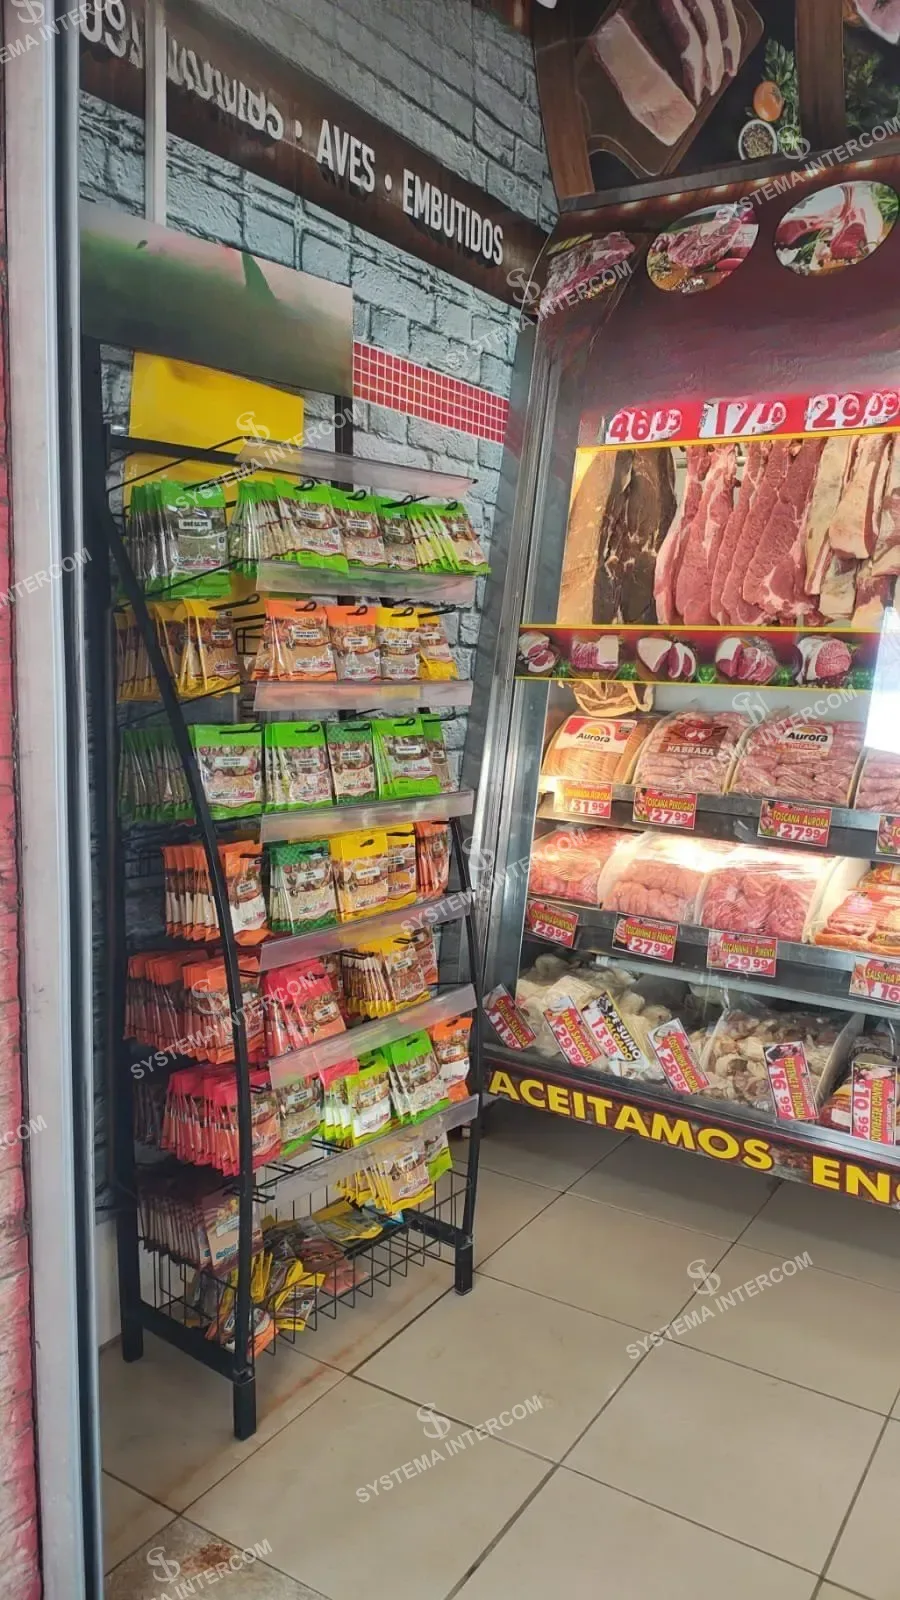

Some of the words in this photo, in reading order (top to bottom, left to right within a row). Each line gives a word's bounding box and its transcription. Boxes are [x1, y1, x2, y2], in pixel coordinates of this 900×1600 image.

[316, 118, 376, 193] AVES
[402, 168, 504, 265] EMBUTIDOS
[576, 732, 611, 743] Aurora
[787, 732, 829, 743] Aurora
[645, 796, 668, 808] TOSCANA
[772, 810, 800, 823] TOSCANA
[802, 815, 828, 827] AURORA
[865, 968, 895, 984] SALSICHA
[570, 1029, 595, 1062] SALGADO
[605, 1017, 633, 1061] SALGADO
[872, 1079, 883, 1105] FRANGO
[871, 1106, 882, 1141] RESFRIADO
[488, 1070, 774, 1170] ACEITAMOS
[812, 1155, 900, 1204] EN
